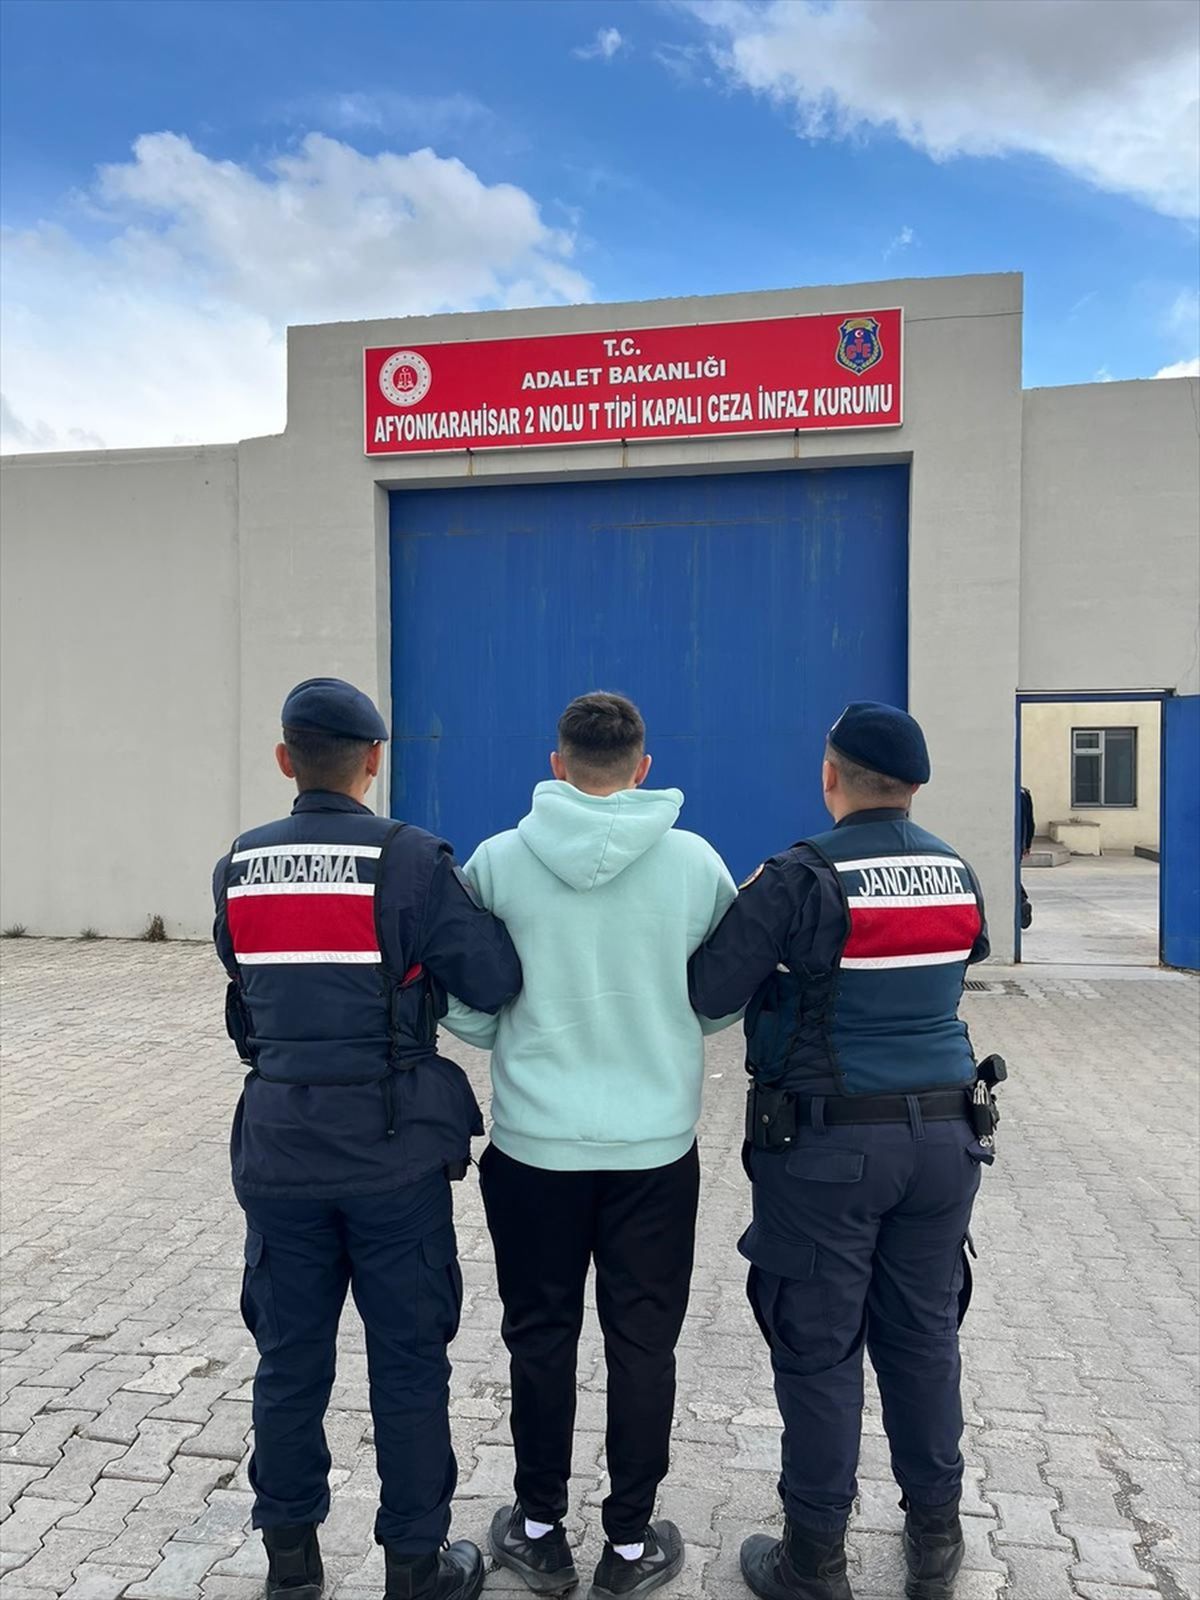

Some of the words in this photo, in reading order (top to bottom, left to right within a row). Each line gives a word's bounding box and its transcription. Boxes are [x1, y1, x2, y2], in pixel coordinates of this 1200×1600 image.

[603, 338, 641, 357] T.C.
[522, 367, 602, 390] ADALET
[609, 356, 726, 385] BAKANLIĞI
[374, 402, 520, 443] AFYONKARAHİSAR
[525, 404, 535, 434] 2
[539, 402, 584, 433] NOLU
[589, 401, 600, 430] T
[604, 393, 636, 429] TİPİ
[641, 395, 702, 427] KAPALI
[707, 392, 753, 423] CEZA
[758, 385, 809, 420] İNFAZ
[814, 383, 893, 417] KURUMU
[240, 855, 359, 885] JANDARMA
[858, 864, 964, 897] JANDARMA
